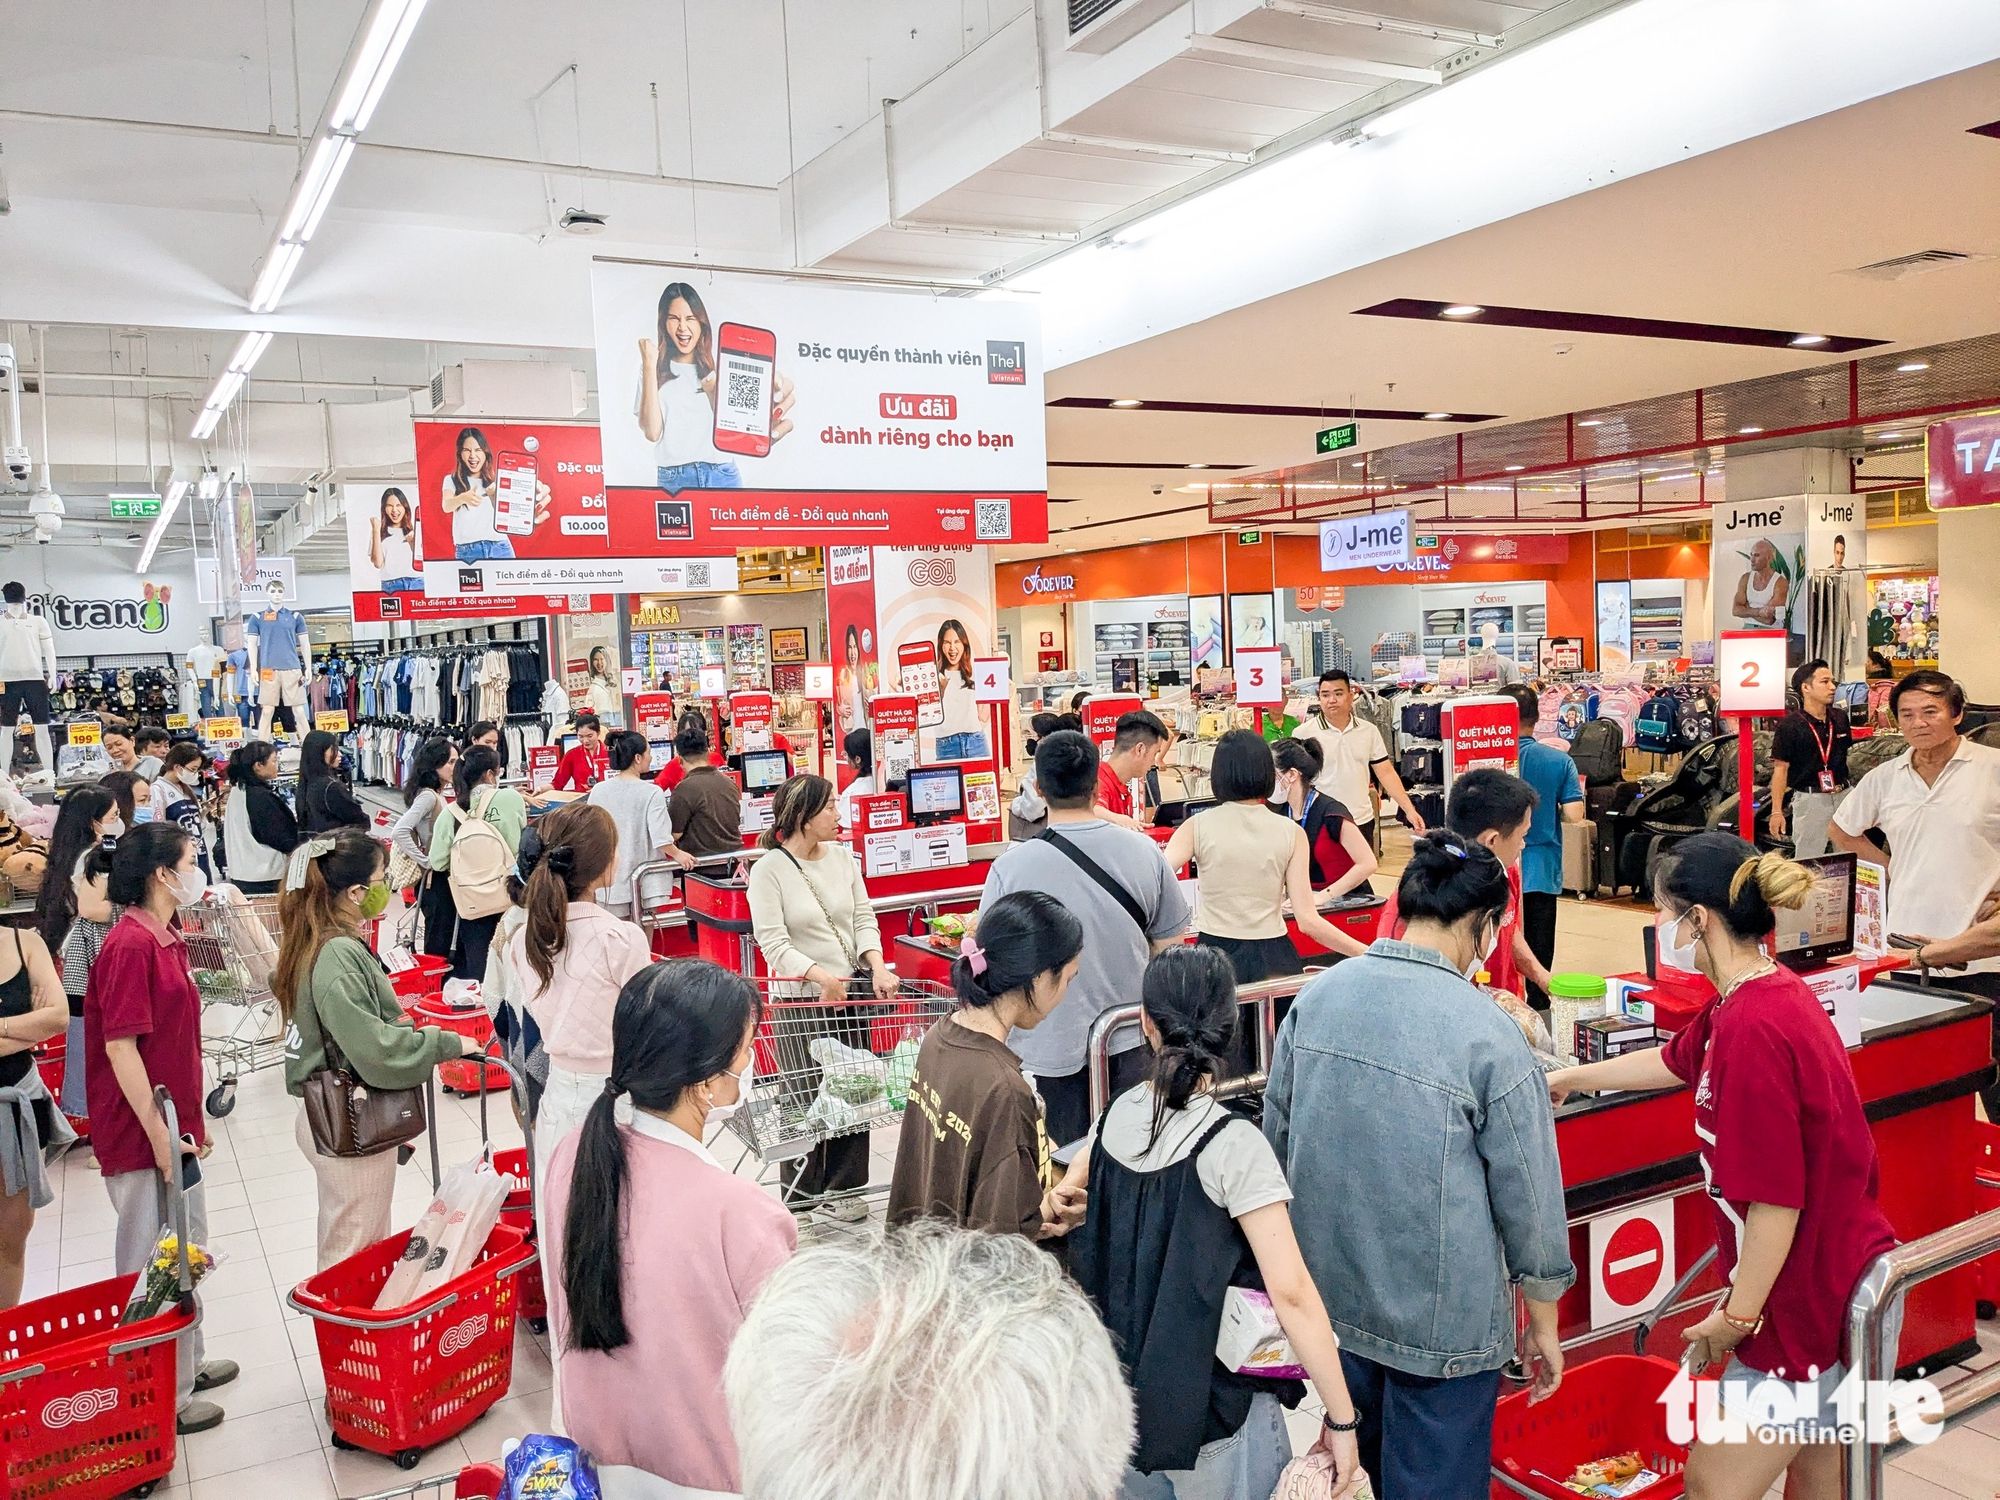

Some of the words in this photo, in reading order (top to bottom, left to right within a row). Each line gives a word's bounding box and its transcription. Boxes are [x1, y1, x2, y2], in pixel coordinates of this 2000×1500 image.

[798, 343, 832, 362] Đặc
[837, 345, 890, 363] quyền
[894, 348, 942, 364] thành
[948, 350, 982, 366] viên
[885, 396, 913, 416] Ưu
[918, 398, 950, 416] đãi
[820, 426, 872, 444] dành
[878, 428, 930, 450] riêng
[936, 430, 972, 446] cho
[978, 430, 1014, 452] bạn
[1337, 428, 1351, 438] EXIT
[557, 462, 582, 476] Đặc
[710, 508, 736, 520] Tích
[740, 505, 770, 520] điểm
[774, 506, 790, 520] dễ
[801, 506, 823, 520] Đổi
[826, 509, 849, 524] quà
[852, 509, 889, 520] nhanh
[567, 522, 606, 530] 10.000
[1363, 549, 1402, 560] UNDERWEAR
[496, 571, 514, 579] Tích
[516, 569, 538, 578] điểm
[541, 569, 552, 578] dễ
[560, 568, 576, 578] Đổi
[578, 570, 594, 579] quà
[596, 570, 623, 578] nhanh
[834, 565, 844, 582] 50
[846, 557, 868, 579] điểm
[908, 558, 956, 586] GO!
[1022, 566, 1074, 595] FOREVER
[428, 598, 446, 606] điểm
[448, 598, 458, 606] dễ
[478, 598, 492, 606] quà
[1474, 591, 1506, 604] FOREVER
[1154, 606, 1188, 618] FOREVER
[984, 674, 996, 688] 4
[1249, 668, 1264, 686] 3
[1740, 662, 1760, 688] 2
[627, 678, 634, 686] 7
[706, 678, 714, 688] 6
[813, 676, 822, 688] 5
[322, 722, 340, 730] 179
[1094, 716, 1112, 724] QUÉT
[212, 729, 234, 738] 199
[1459, 726, 1482, 738] QUÉT
[1483, 724, 1497, 736] MÃ
[1498, 726, 1512, 735] QR
[74, 735, 92, 744] 199
[1456, 740, 1471, 750] Săn
[1473, 739, 1490, 748] Deal
[1492, 736, 1502, 747] tối
[1504, 737, 1514, 746] đa
[523, 1474, 568, 1492] SWAT
